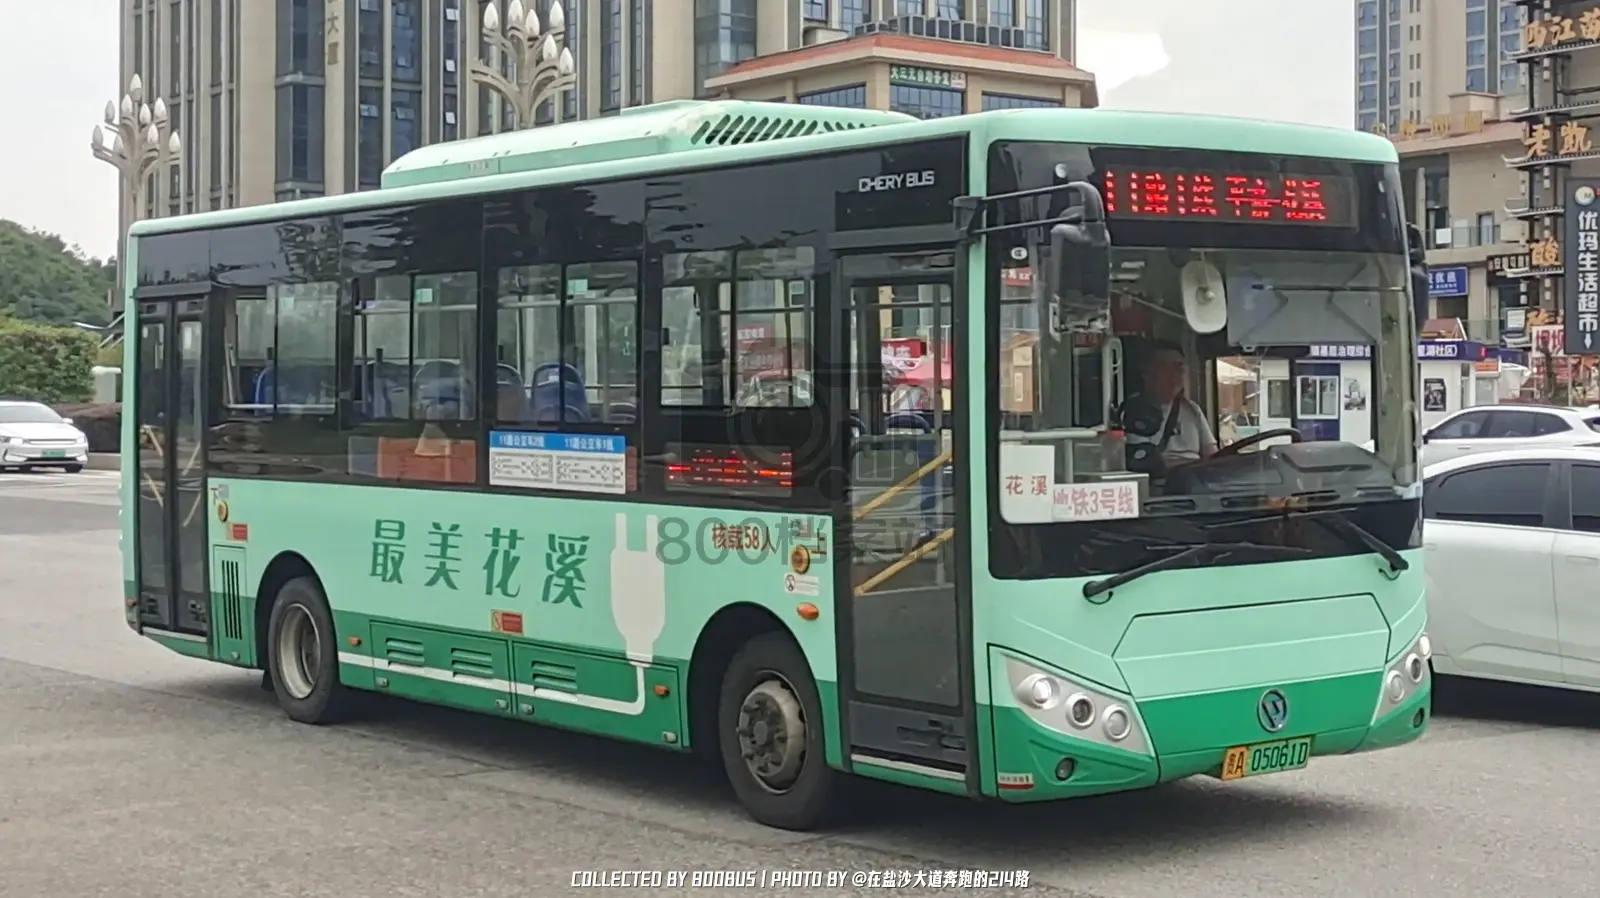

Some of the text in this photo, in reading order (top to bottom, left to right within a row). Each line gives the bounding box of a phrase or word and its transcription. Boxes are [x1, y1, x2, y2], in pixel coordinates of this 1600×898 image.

[858, 170, 935, 193] CHERY BUS
[1578, 211, 1599, 332] 优玛生活超市
[1005, 475, 1048, 496] 花溪
[711, 523, 777, 555] 核载58人
[811, 527, 828, 555] 上
[369, 518, 590, 609] 最美花溪
